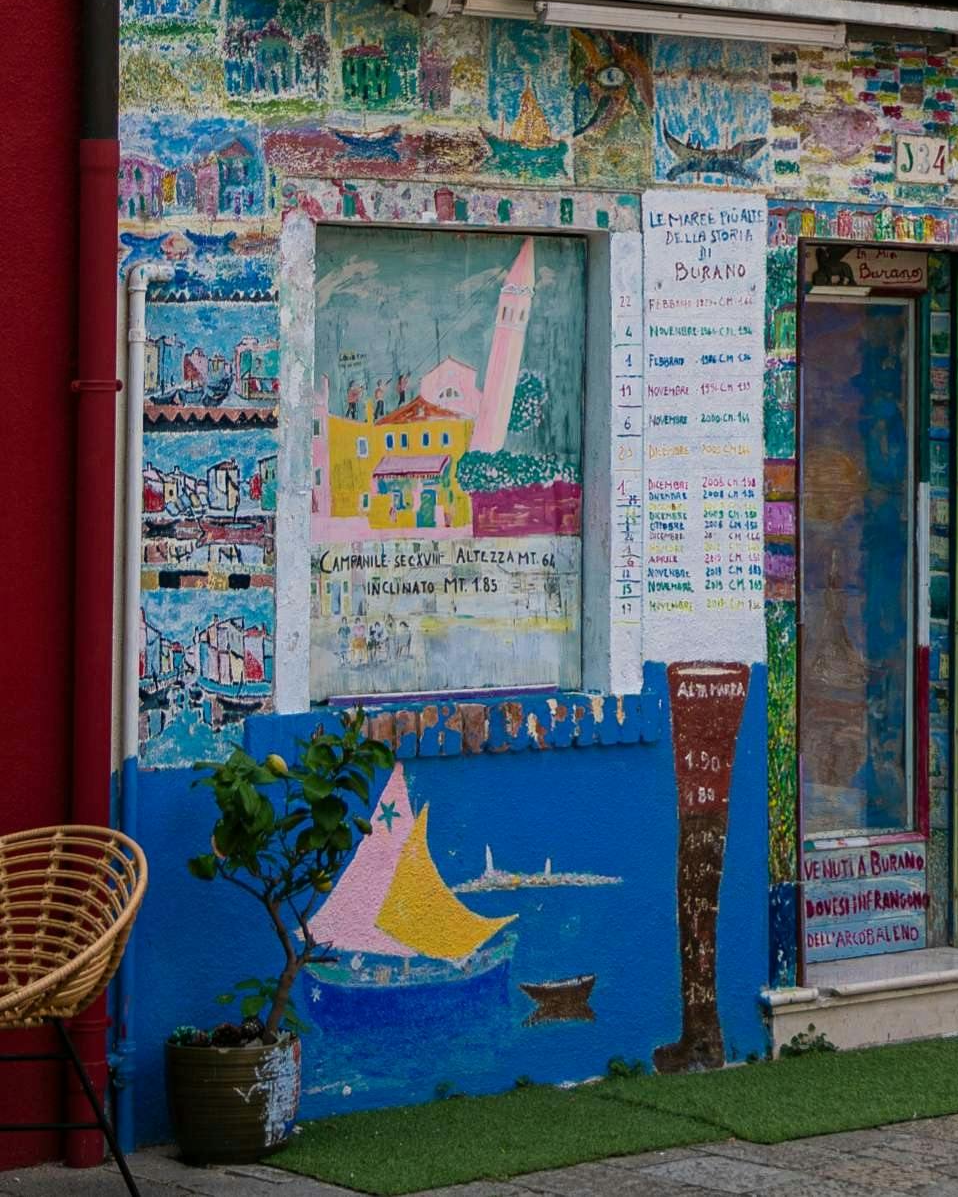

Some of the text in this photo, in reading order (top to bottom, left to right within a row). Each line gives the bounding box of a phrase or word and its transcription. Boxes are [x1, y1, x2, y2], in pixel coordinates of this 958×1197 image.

[650, 211, 663, 228] LE
[665, 229, 753, 244] DELLA STORIA
[698, 246, 711, 261] DI
[675, 262, 746, 283] BURANO
[859, 263, 923, 284] Burano
[619, 295, 632, 308] 22
[647, 384, 689, 398] NOVEMBRE
[624, 415, 632, 430] 6
[649, 414, 688, 427] NOVEMBRE
[456, 547, 514, 564] ALTEZZA
[542, 553, 556, 568] 64
[367, 581, 435, 596] INCLINATO
[471, 576, 498, 593] 1.85
[804, 850, 924, 880] VENUTI A BURANO
[807, 924, 920, 948] DELL'ARCOBALENO
